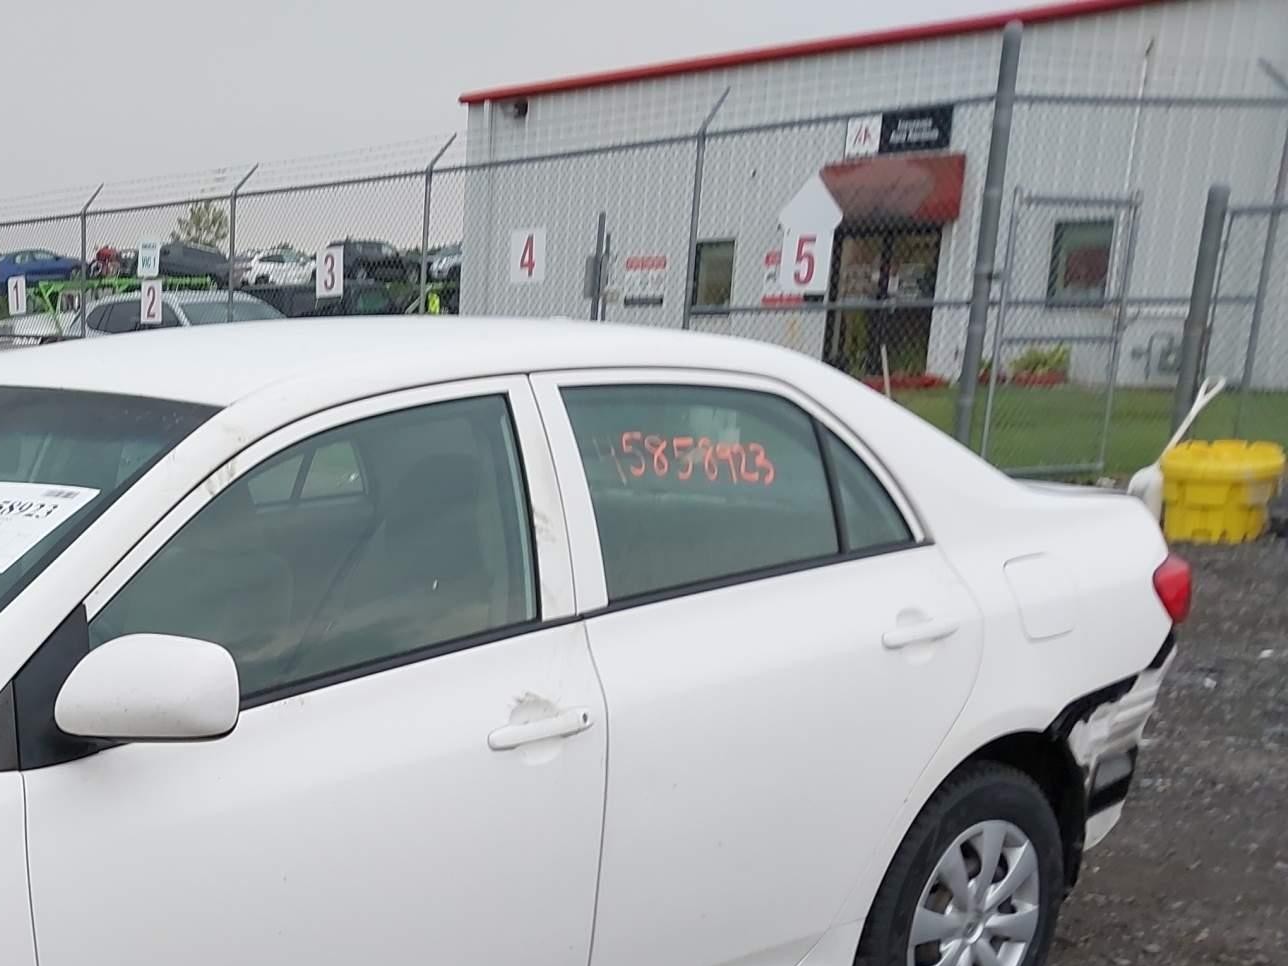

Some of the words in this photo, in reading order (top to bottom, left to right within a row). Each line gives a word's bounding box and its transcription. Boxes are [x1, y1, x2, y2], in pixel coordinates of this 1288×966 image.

[323, 253, 336, 291] 3
[519, 233, 536, 278] 4
[793, 234, 818, 285] 5
[12, 281, 21, 311] 1
[145, 285, 157, 319] 2
